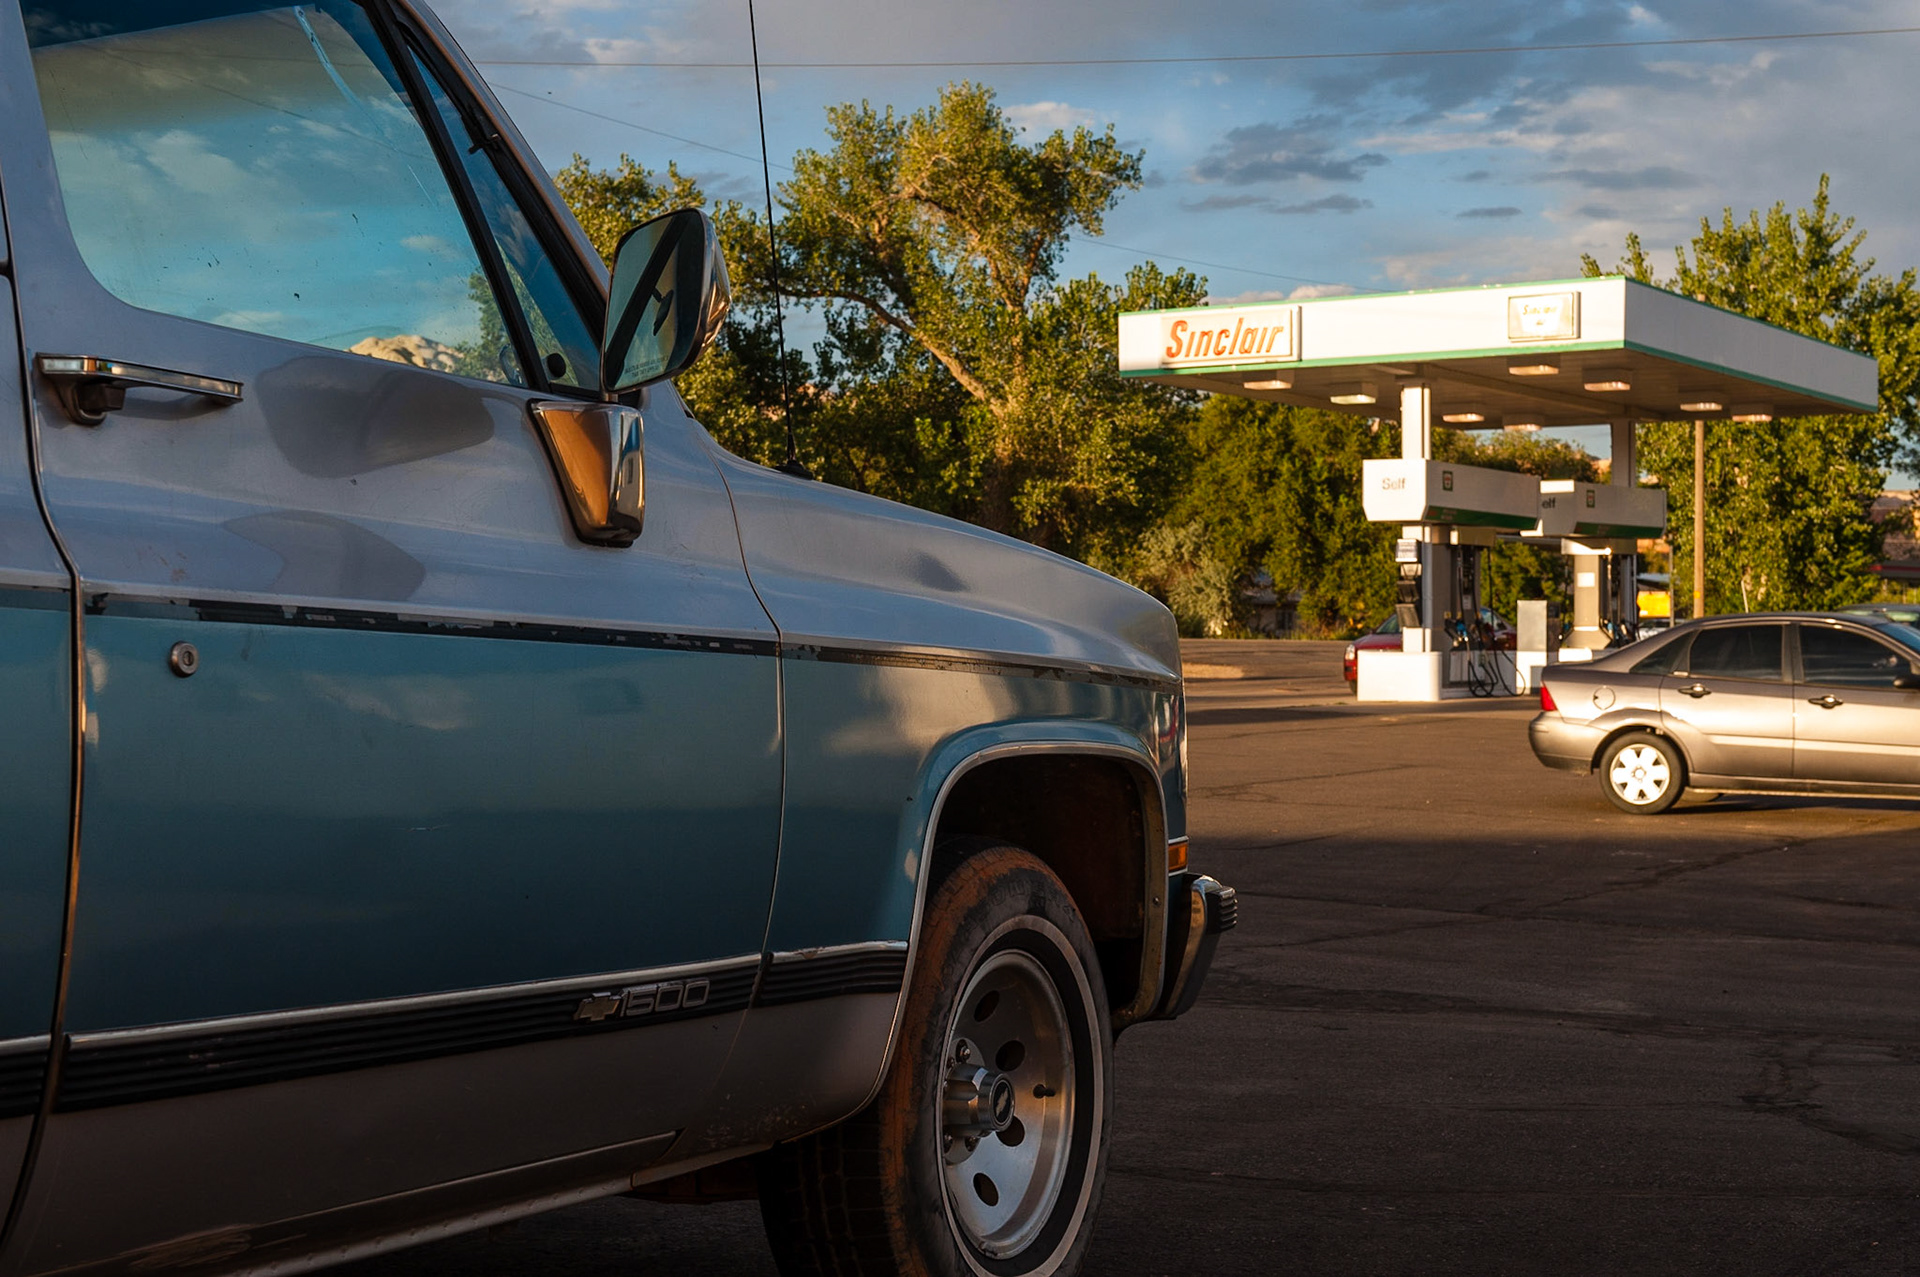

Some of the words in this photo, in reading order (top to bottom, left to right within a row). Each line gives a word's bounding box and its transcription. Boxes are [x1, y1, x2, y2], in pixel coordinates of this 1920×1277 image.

[1165, 317, 1284, 359] Sinclair
[1381, 477, 1406, 490] Self
[1541, 497, 1556, 509] elf
[619, 977, 711, 1017] 1500
